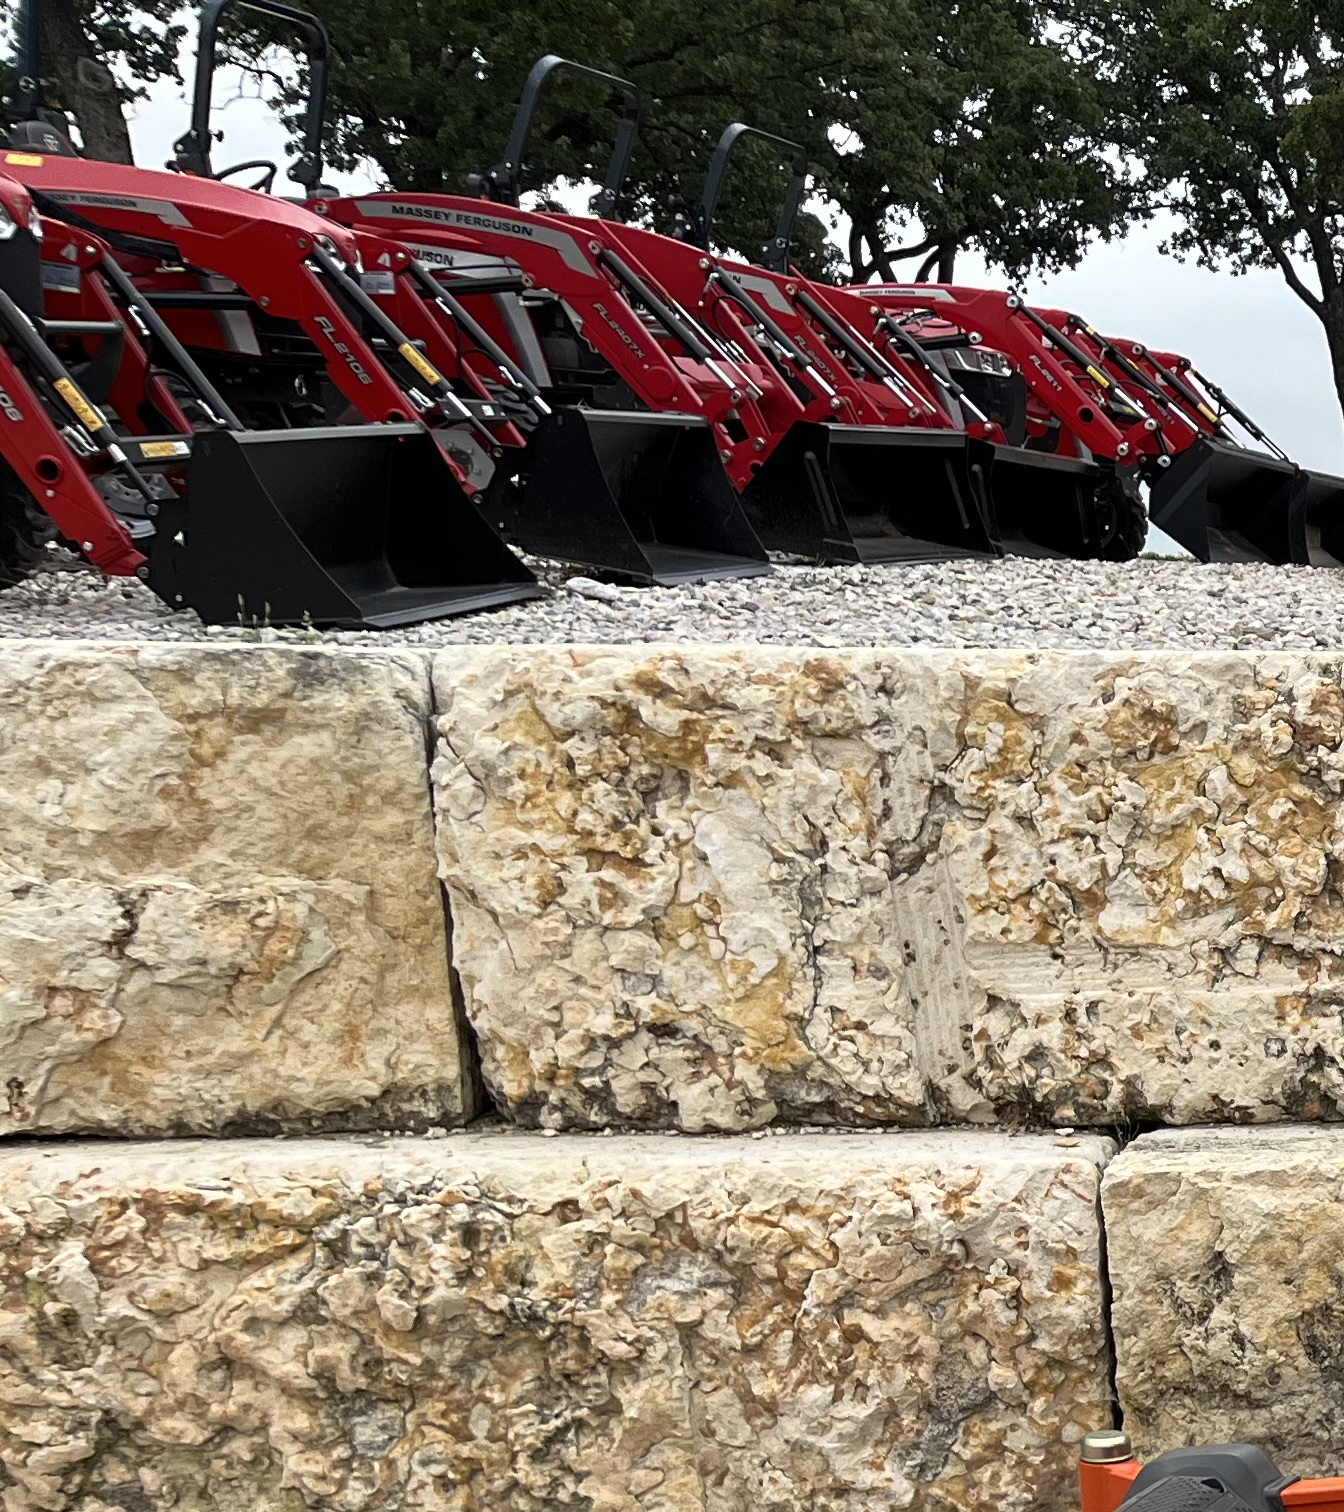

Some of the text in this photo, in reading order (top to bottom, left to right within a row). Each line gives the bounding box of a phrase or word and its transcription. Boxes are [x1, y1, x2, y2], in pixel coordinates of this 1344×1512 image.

[391, 205, 533, 237] MASSEY FERGUSON
[415, 249, 455, 267] USON
[313, 316, 373, 385] FL2106
